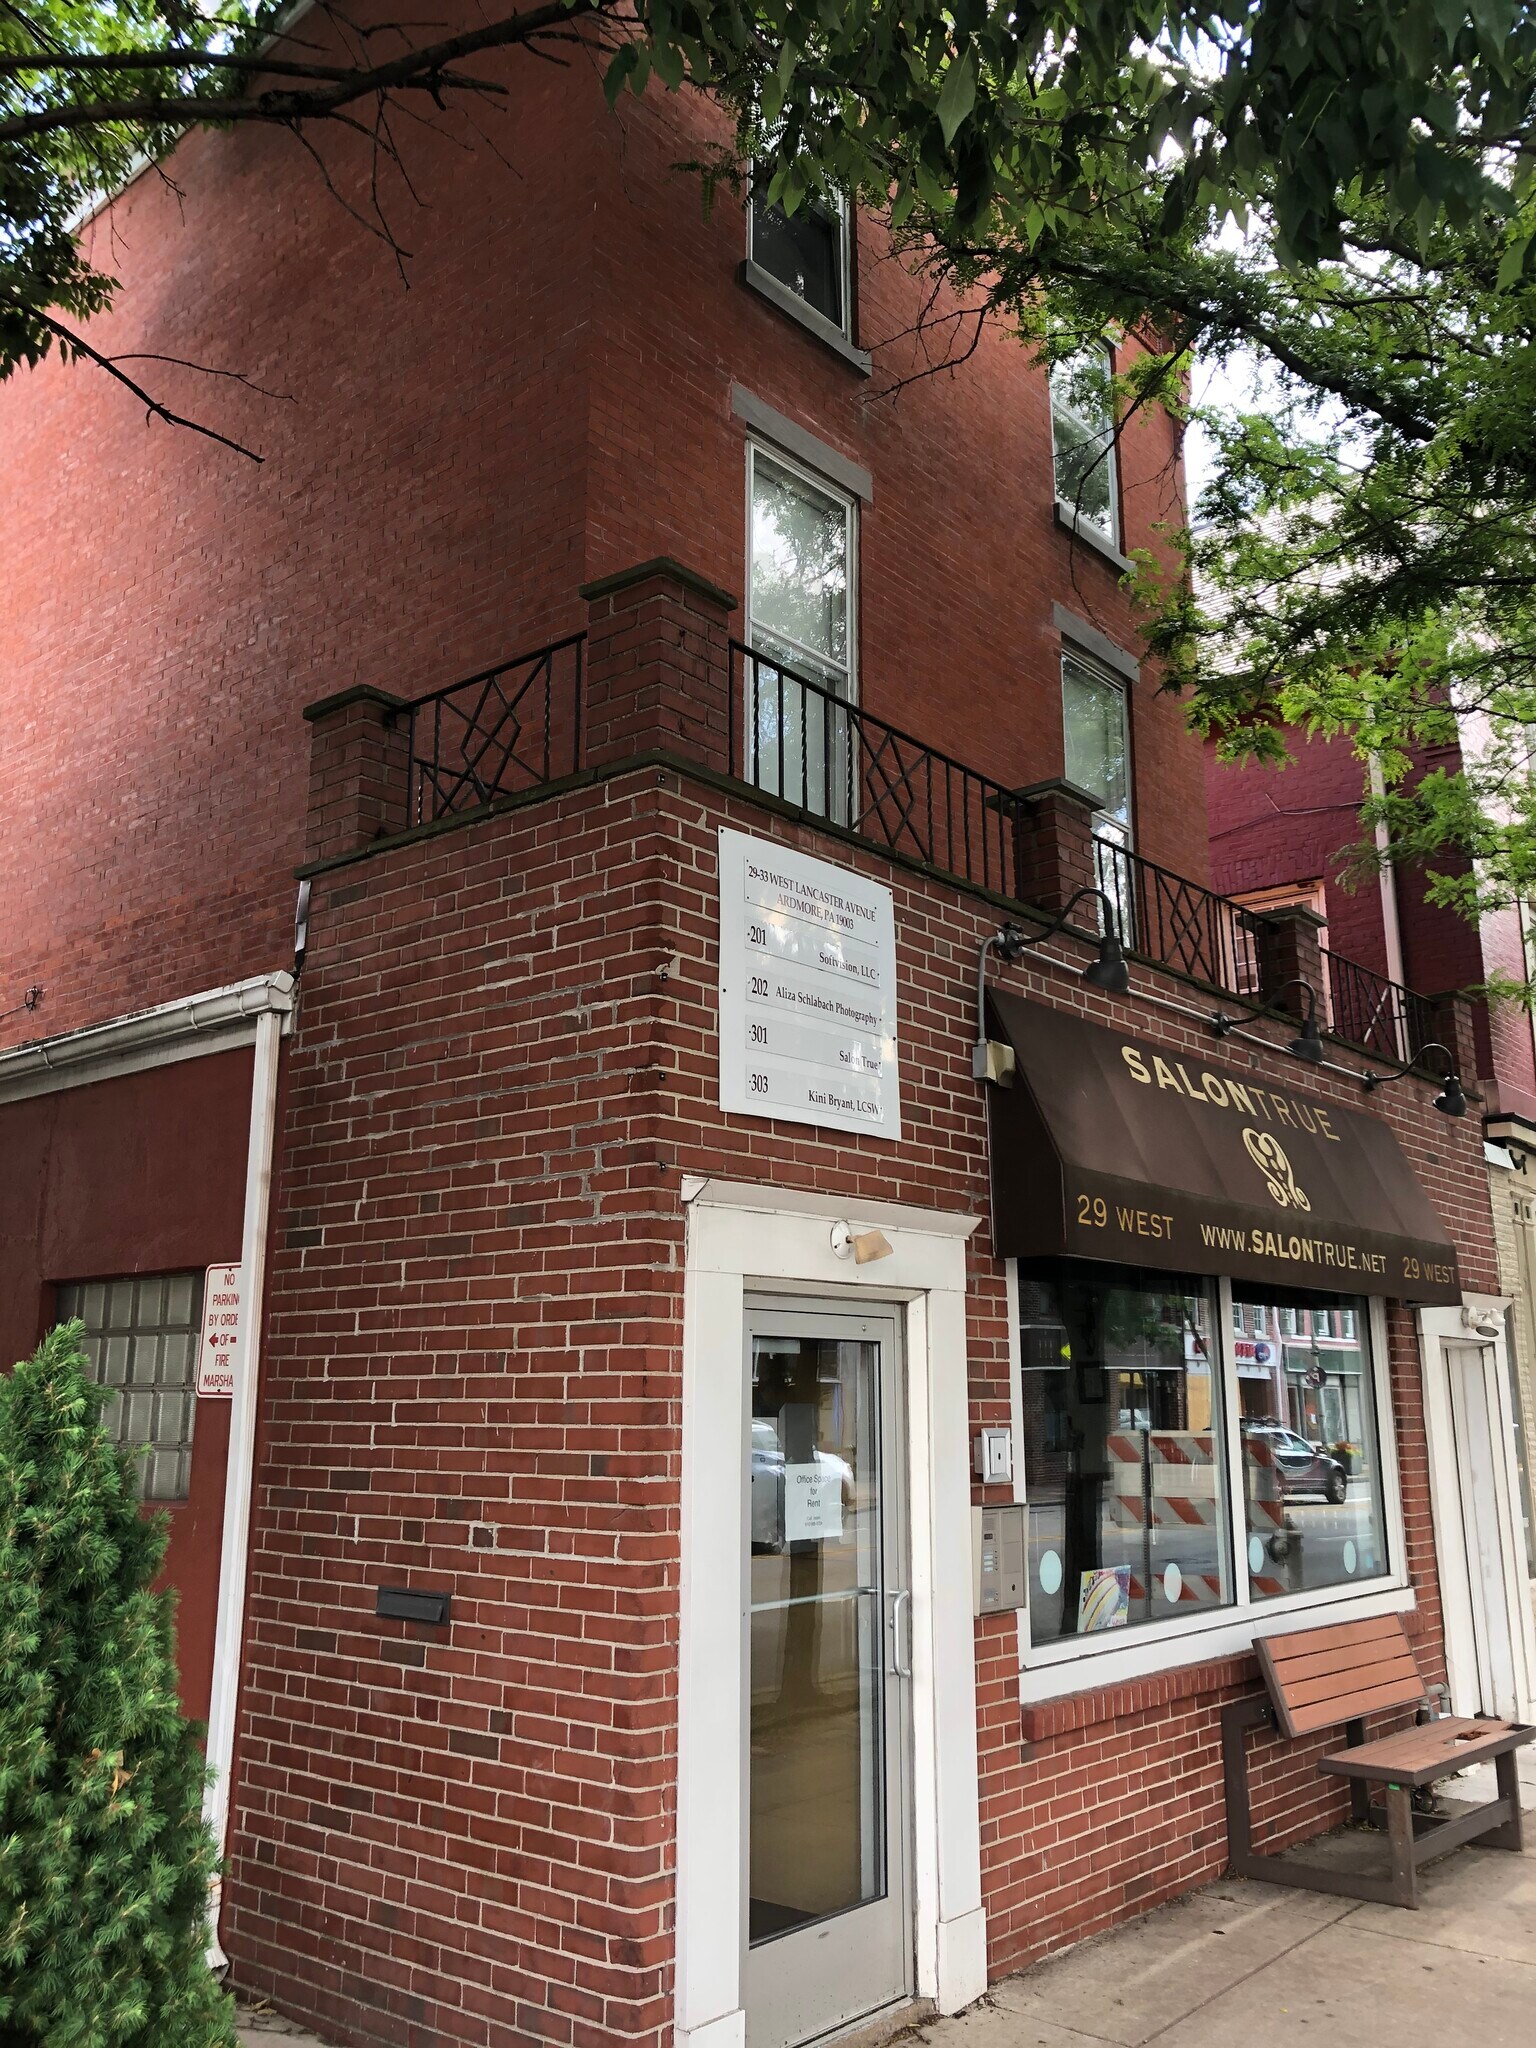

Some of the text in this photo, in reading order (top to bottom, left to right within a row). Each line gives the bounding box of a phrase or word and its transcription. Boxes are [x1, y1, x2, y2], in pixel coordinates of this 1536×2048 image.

[748, 865, 876, 922] 29-33 WEST LANCASTER AVENUE
[776, 893, 854, 930] ARDMORE, PA 19003
[750, 925, 767, 946] 201
[819, 951, 876, 980] Softvision, LLC
[751, 976, 769, 997] 202
[775, 985, 878, 1027] Aliza Schlabach Photography
[751, 1024, 768, 1044] 301
[839, 1050, 878, 1070] Salon True
[750, 1073, 769, 1093] 303
[808, 1089, 879, 1115] Kini Bryant, LCSW
[1076, 1193, 1174, 1240] 29 WEST
[1200, 1223, 1387, 1274] WWW.SALONTRUE.NET
[224, 1273, 236, 1286] NO
[1402, 1256, 1455, 1285] 29 WEST
[212, 1293, 240, 1306] PARKIN
[208, 1313, 239, 1327] BY ORDE
[220, 1333, 230, 1346] OF
[215, 1353, 230, 1367] FIRE
[203, 1374, 234, 1387] MARSHA
[796, 1474, 813, 1484] Office
[809, 1487, 818, 1496] for
[807, 1499, 821, 1508] Rent
